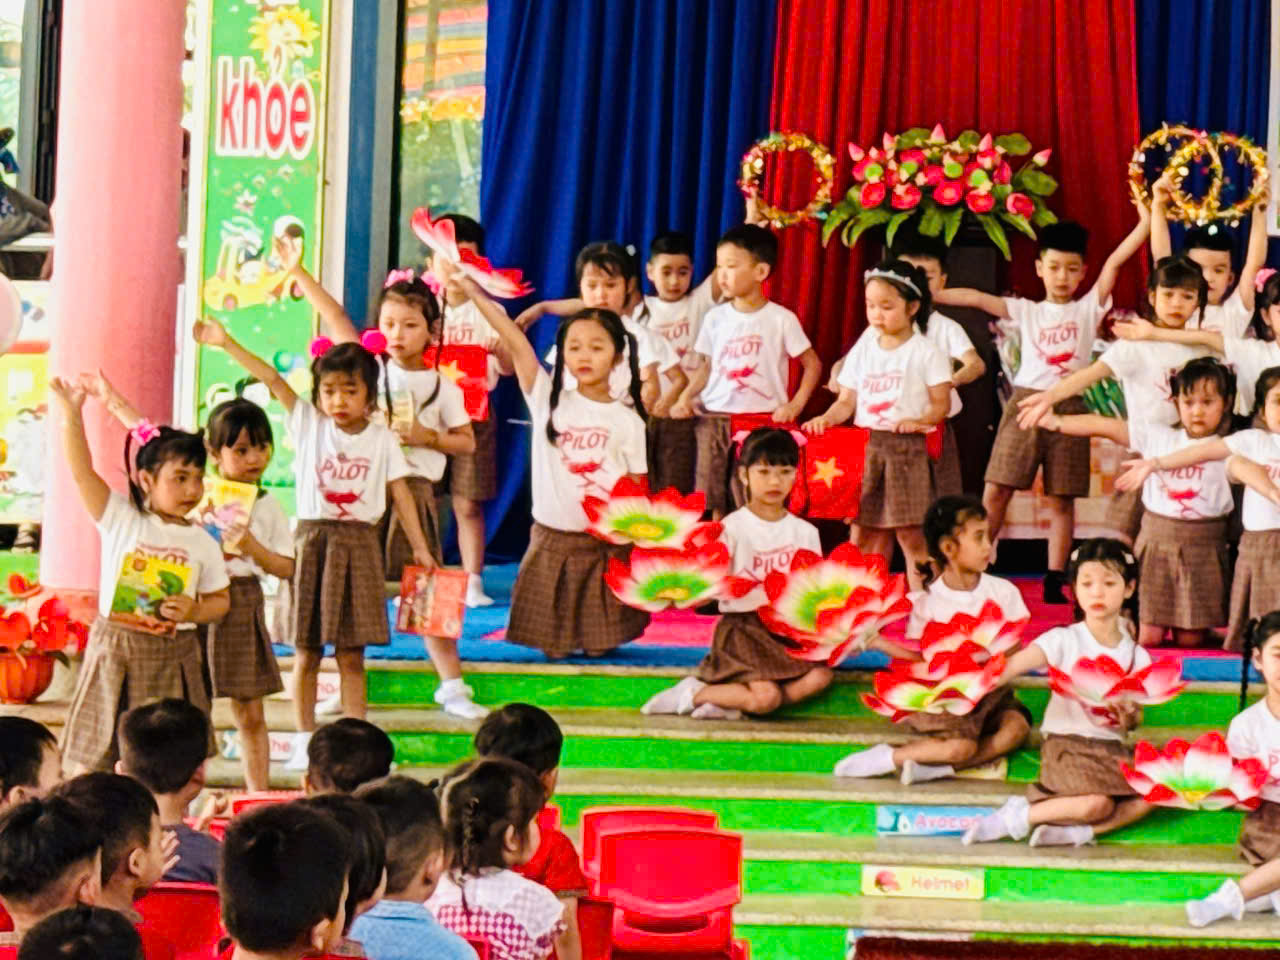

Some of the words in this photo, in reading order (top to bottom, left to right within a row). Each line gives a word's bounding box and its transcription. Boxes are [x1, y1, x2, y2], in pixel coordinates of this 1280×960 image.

[1040, 326, 1079, 346] PILOT
[720, 341, 761, 360] PILOT
[861, 377, 902, 394] PILOT
[561, 431, 608, 450] PILOT
[322, 458, 369, 481] PILOT
[753, 551, 791, 572] PILO
